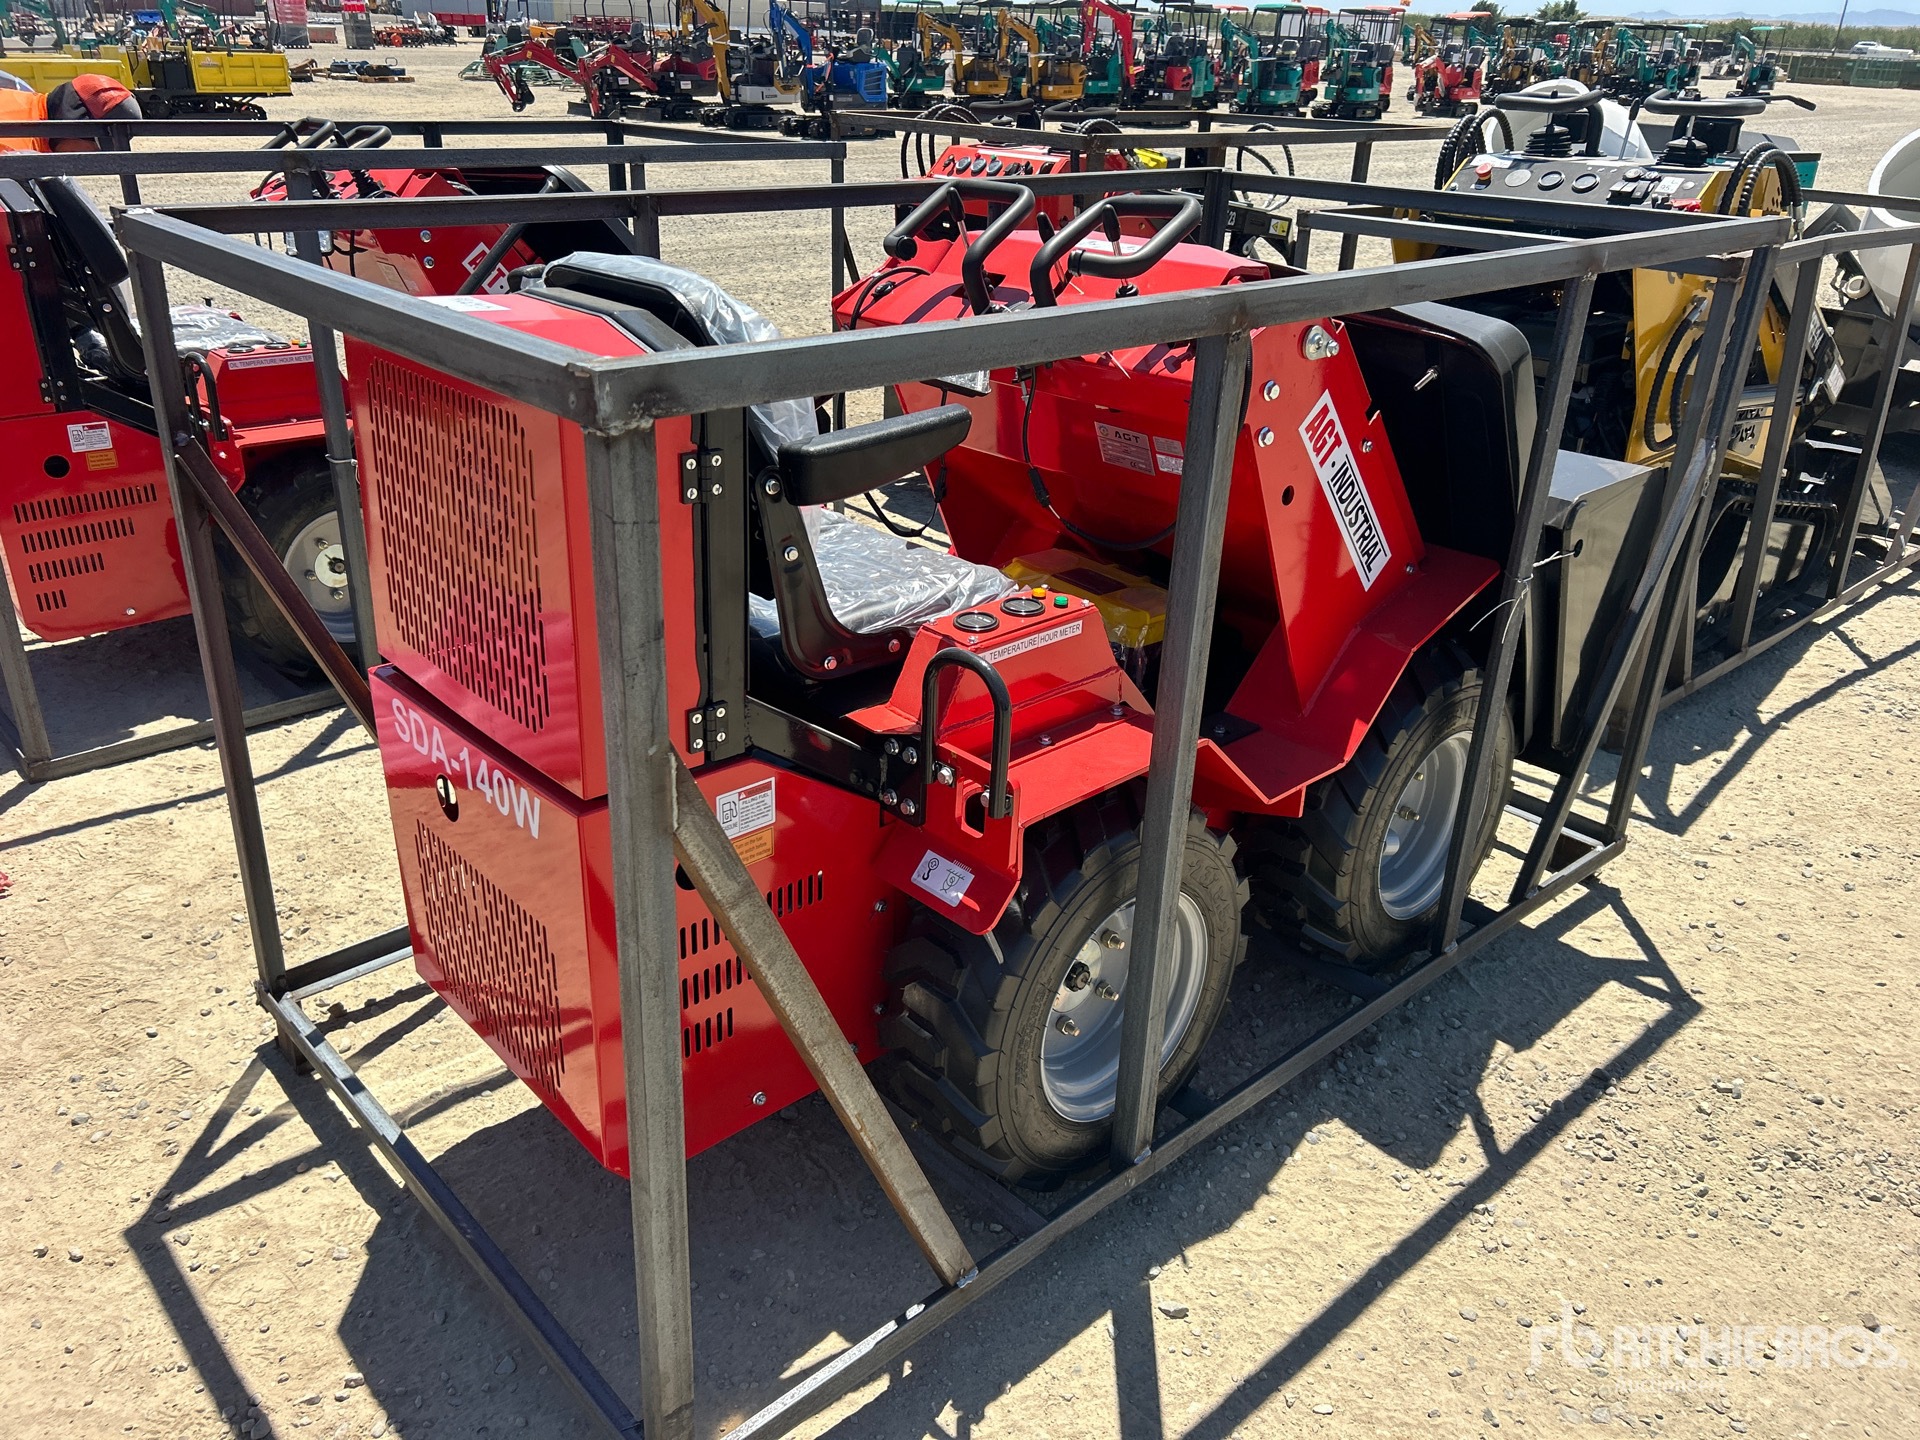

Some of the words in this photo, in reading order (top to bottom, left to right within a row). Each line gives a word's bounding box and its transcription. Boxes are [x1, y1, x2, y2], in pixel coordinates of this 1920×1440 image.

[467, 249, 507, 289] AT
[1114, 431, 1140, 443] AGT
[1304, 402, 1343, 469] AGT
[1330, 460, 1384, 574] INDUSTRIAL
[1059, 623, 1081, 637] METER
[391, 697, 541, 840] SDA-140W
